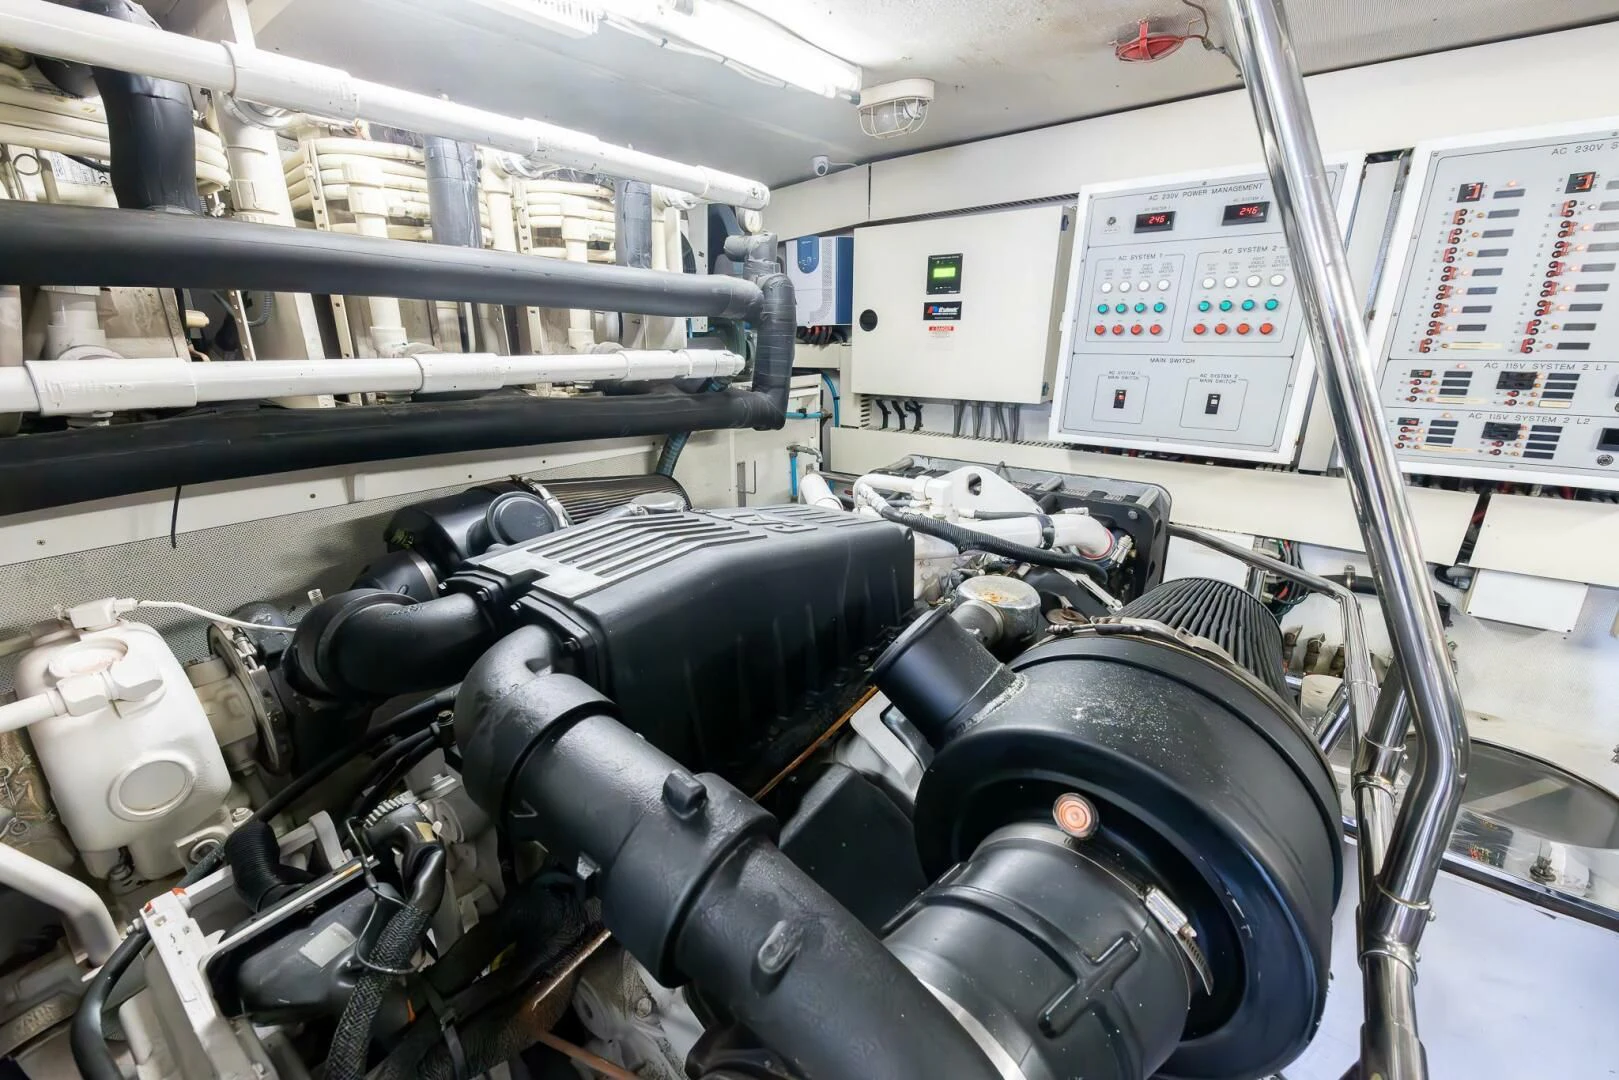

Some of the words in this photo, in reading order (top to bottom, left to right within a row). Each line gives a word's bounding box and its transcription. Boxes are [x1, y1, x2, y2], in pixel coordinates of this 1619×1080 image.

[1552, 147, 1568, 156] AC
[1574, 143, 1604, 154] 230V
[1182, 189, 1208, 197] POWER
[1211, 183, 1263, 194] MANAGEMENT
[1240, 206, 1258, 215] 246
[1148, 216, 1165, 224] 246
[1514, 415, 1557, 423] SYSTEM
